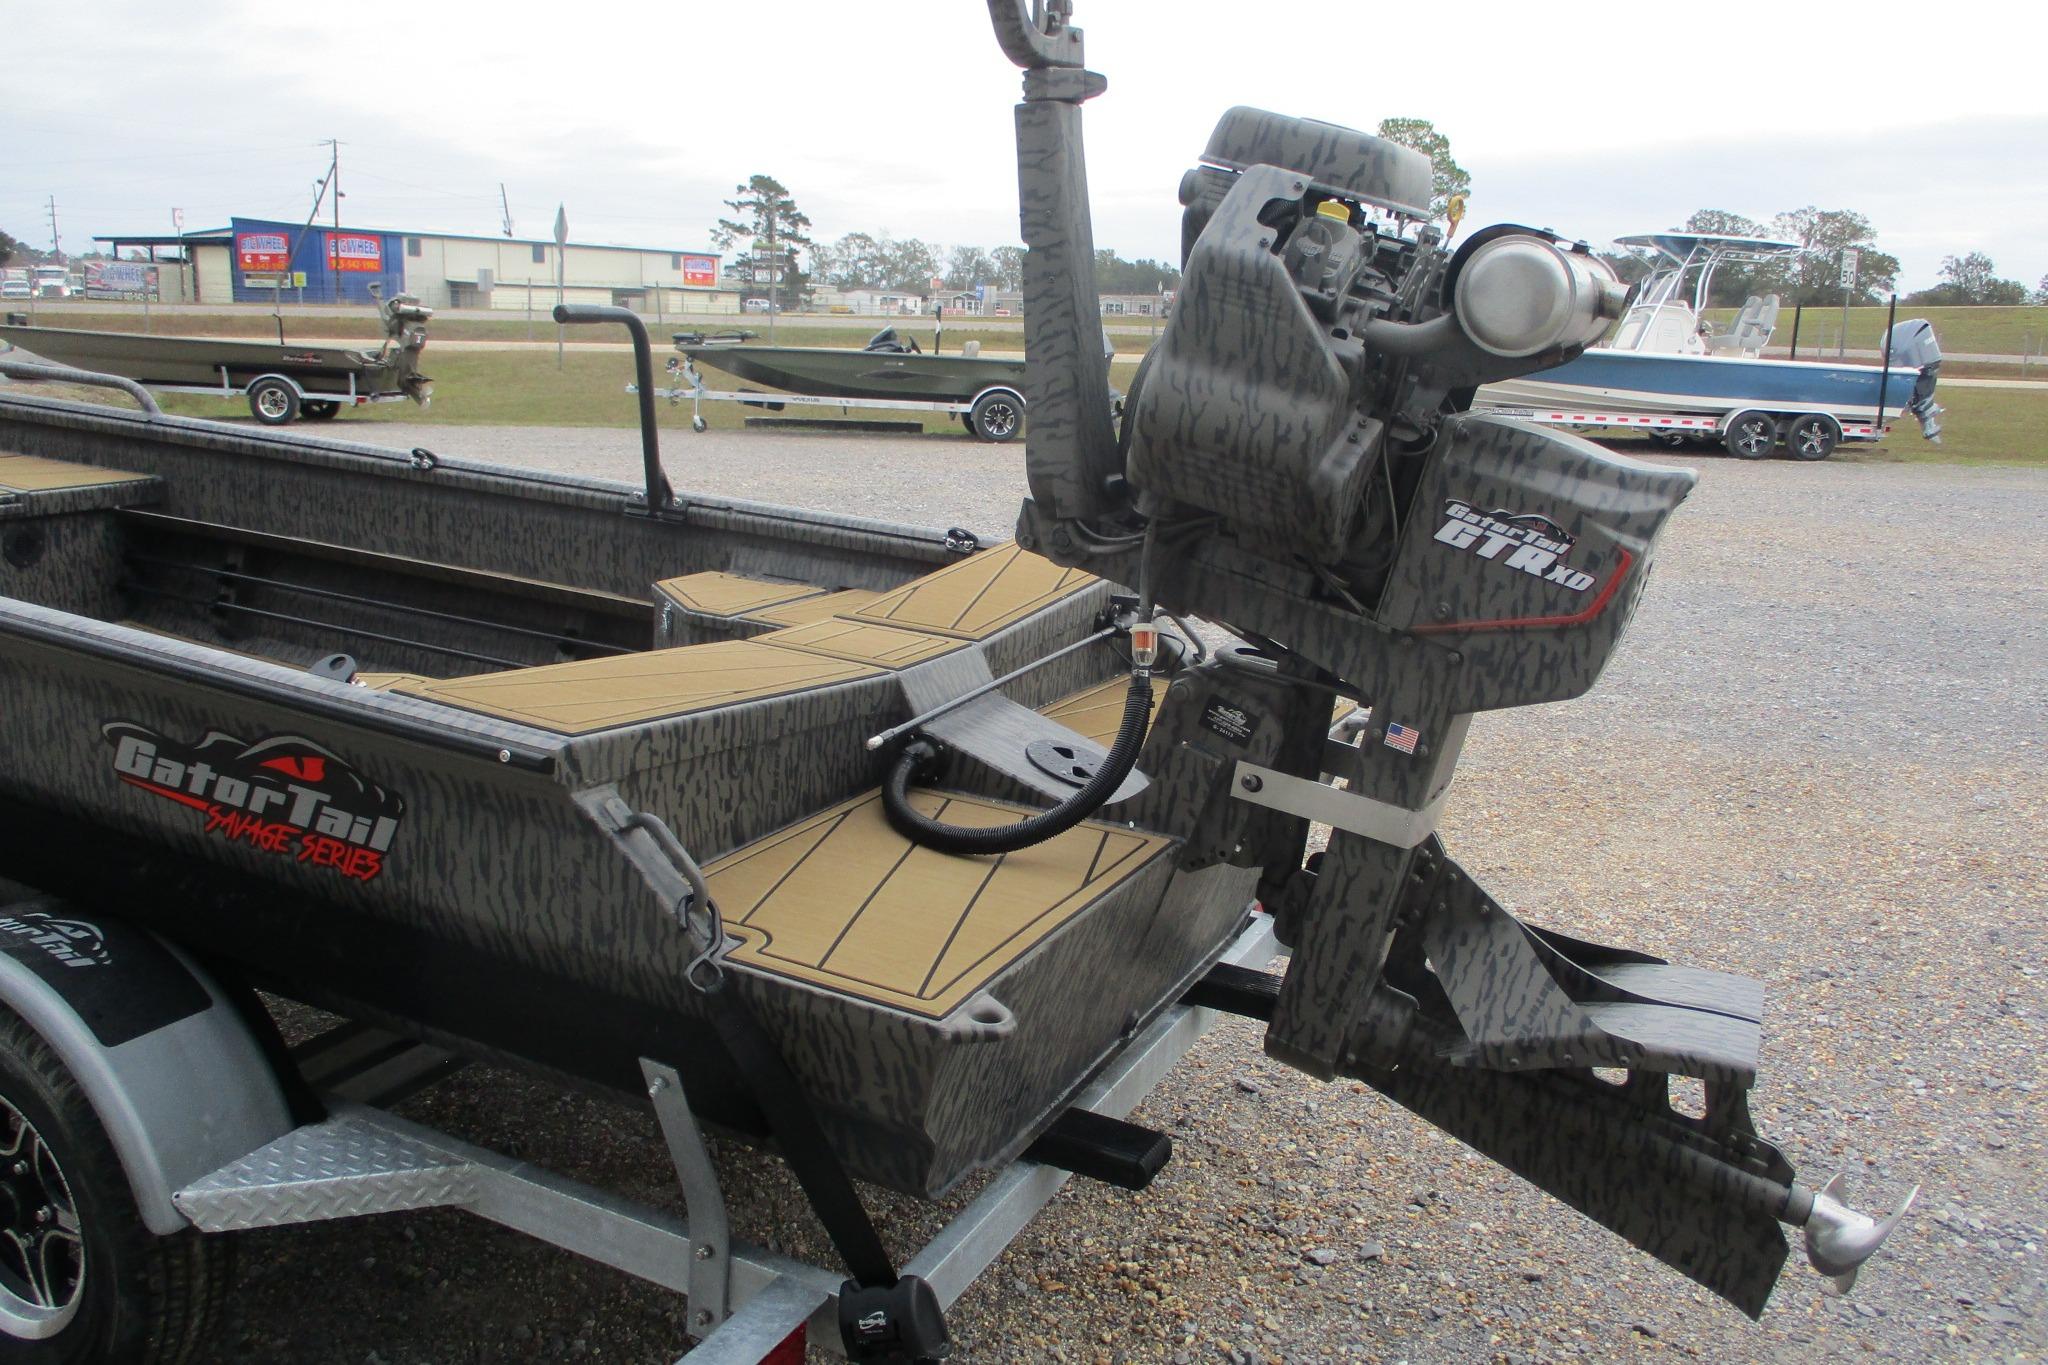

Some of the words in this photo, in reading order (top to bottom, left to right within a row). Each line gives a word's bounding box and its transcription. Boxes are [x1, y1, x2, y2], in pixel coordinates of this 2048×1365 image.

[256, 236, 288, 250] WHEEL
[330, 239, 347, 253] BG
[347, 239, 381, 254] WHEEL
[1841, 270, 1855, 284] 50
[1433, 518, 1557, 577] GTR
[1544, 563, 1597, 592] XD
[1445, 503, 1571, 555] GatorTail
[114, 735, 398, 852] GatorTail
[205, 805, 303, 852] SAVAGE
[298, 834, 384, 880] SERIES
